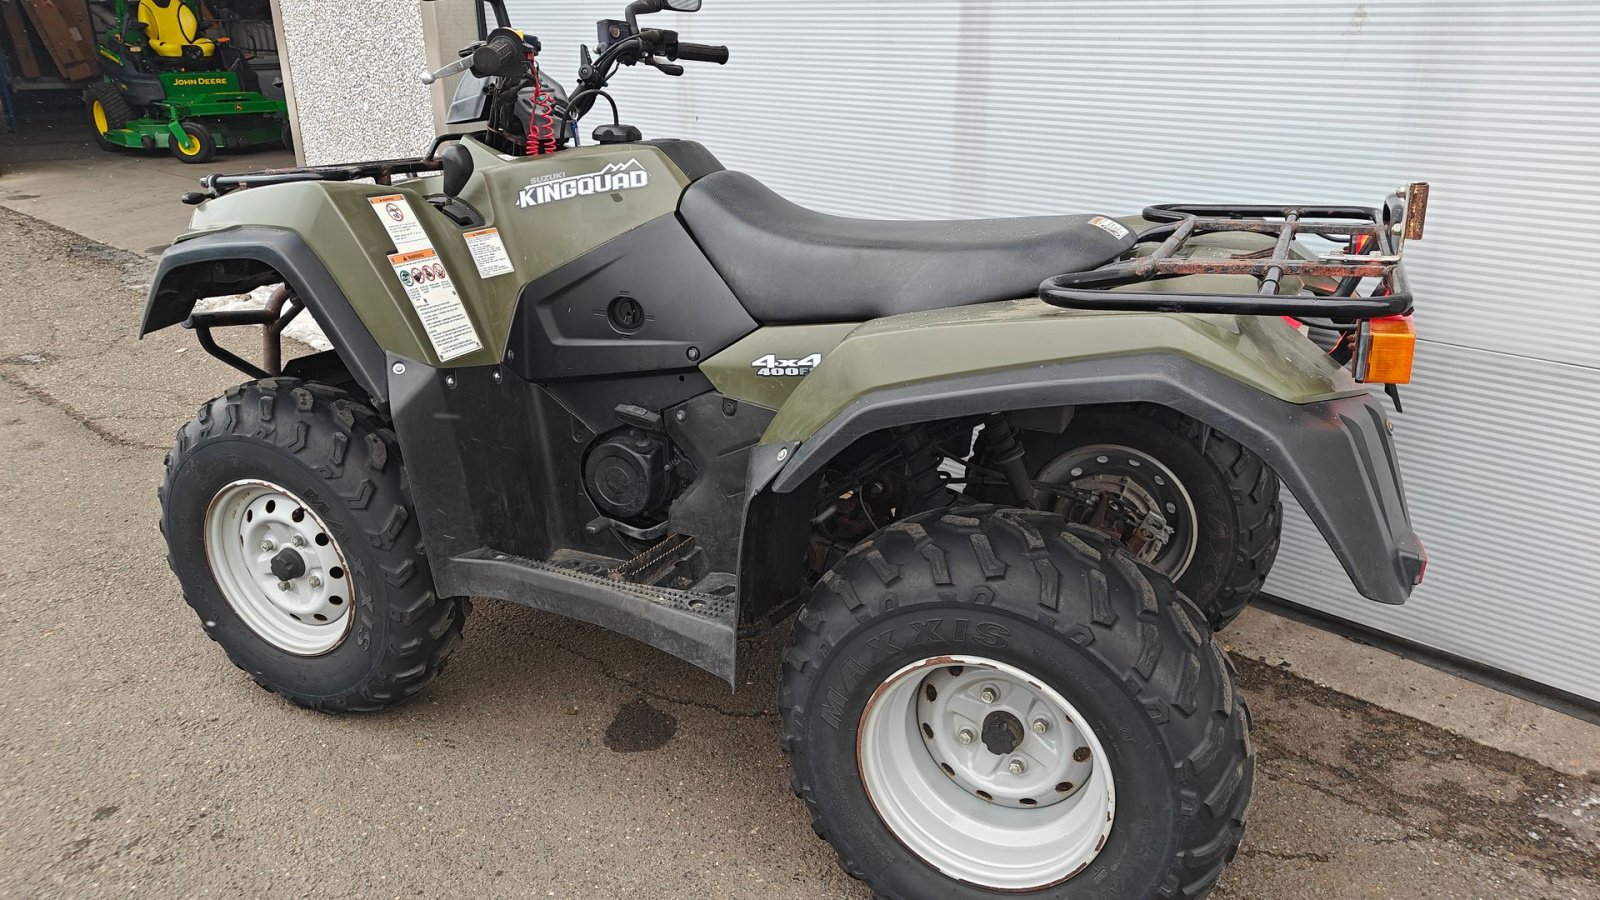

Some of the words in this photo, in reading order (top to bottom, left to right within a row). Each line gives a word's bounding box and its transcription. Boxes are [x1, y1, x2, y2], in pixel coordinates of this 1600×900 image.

[518, 170, 648, 209] KINGQUAD
[530, 172, 566, 185] SUZUKI
[751, 353, 822, 369] 4x4
[302, 488, 375, 651] MAXXIS
[820, 617, 1012, 731] MAXXIS
